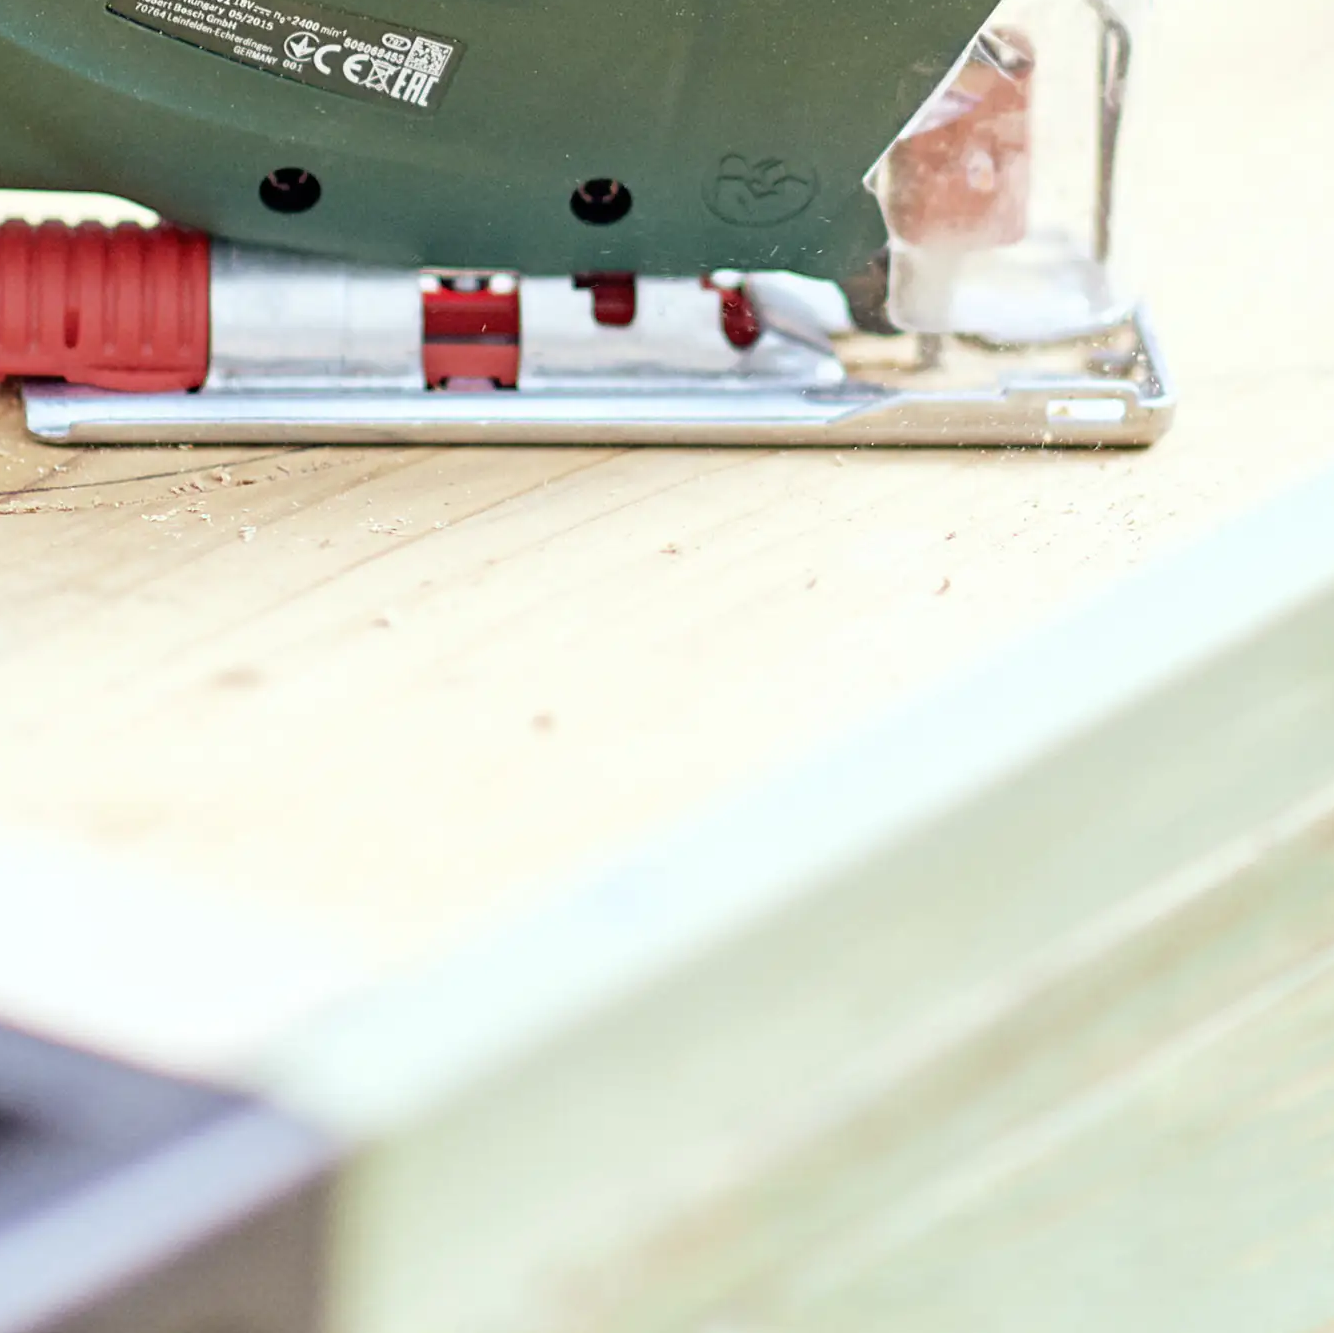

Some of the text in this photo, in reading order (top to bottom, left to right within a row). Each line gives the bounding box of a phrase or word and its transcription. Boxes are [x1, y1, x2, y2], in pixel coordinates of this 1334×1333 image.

[135, 2, 273, 54] 70764 Leinfelden-Echterdingen
[173, 3, 205, 20] Bosch
[206, 14, 237, 30] GmbH
[228, 9, 274, 31] 05/2015
[233, 45, 278, 66] GERMANY
[282, 59, 303, 73] 001
[313, 44, 370, 84] CE
